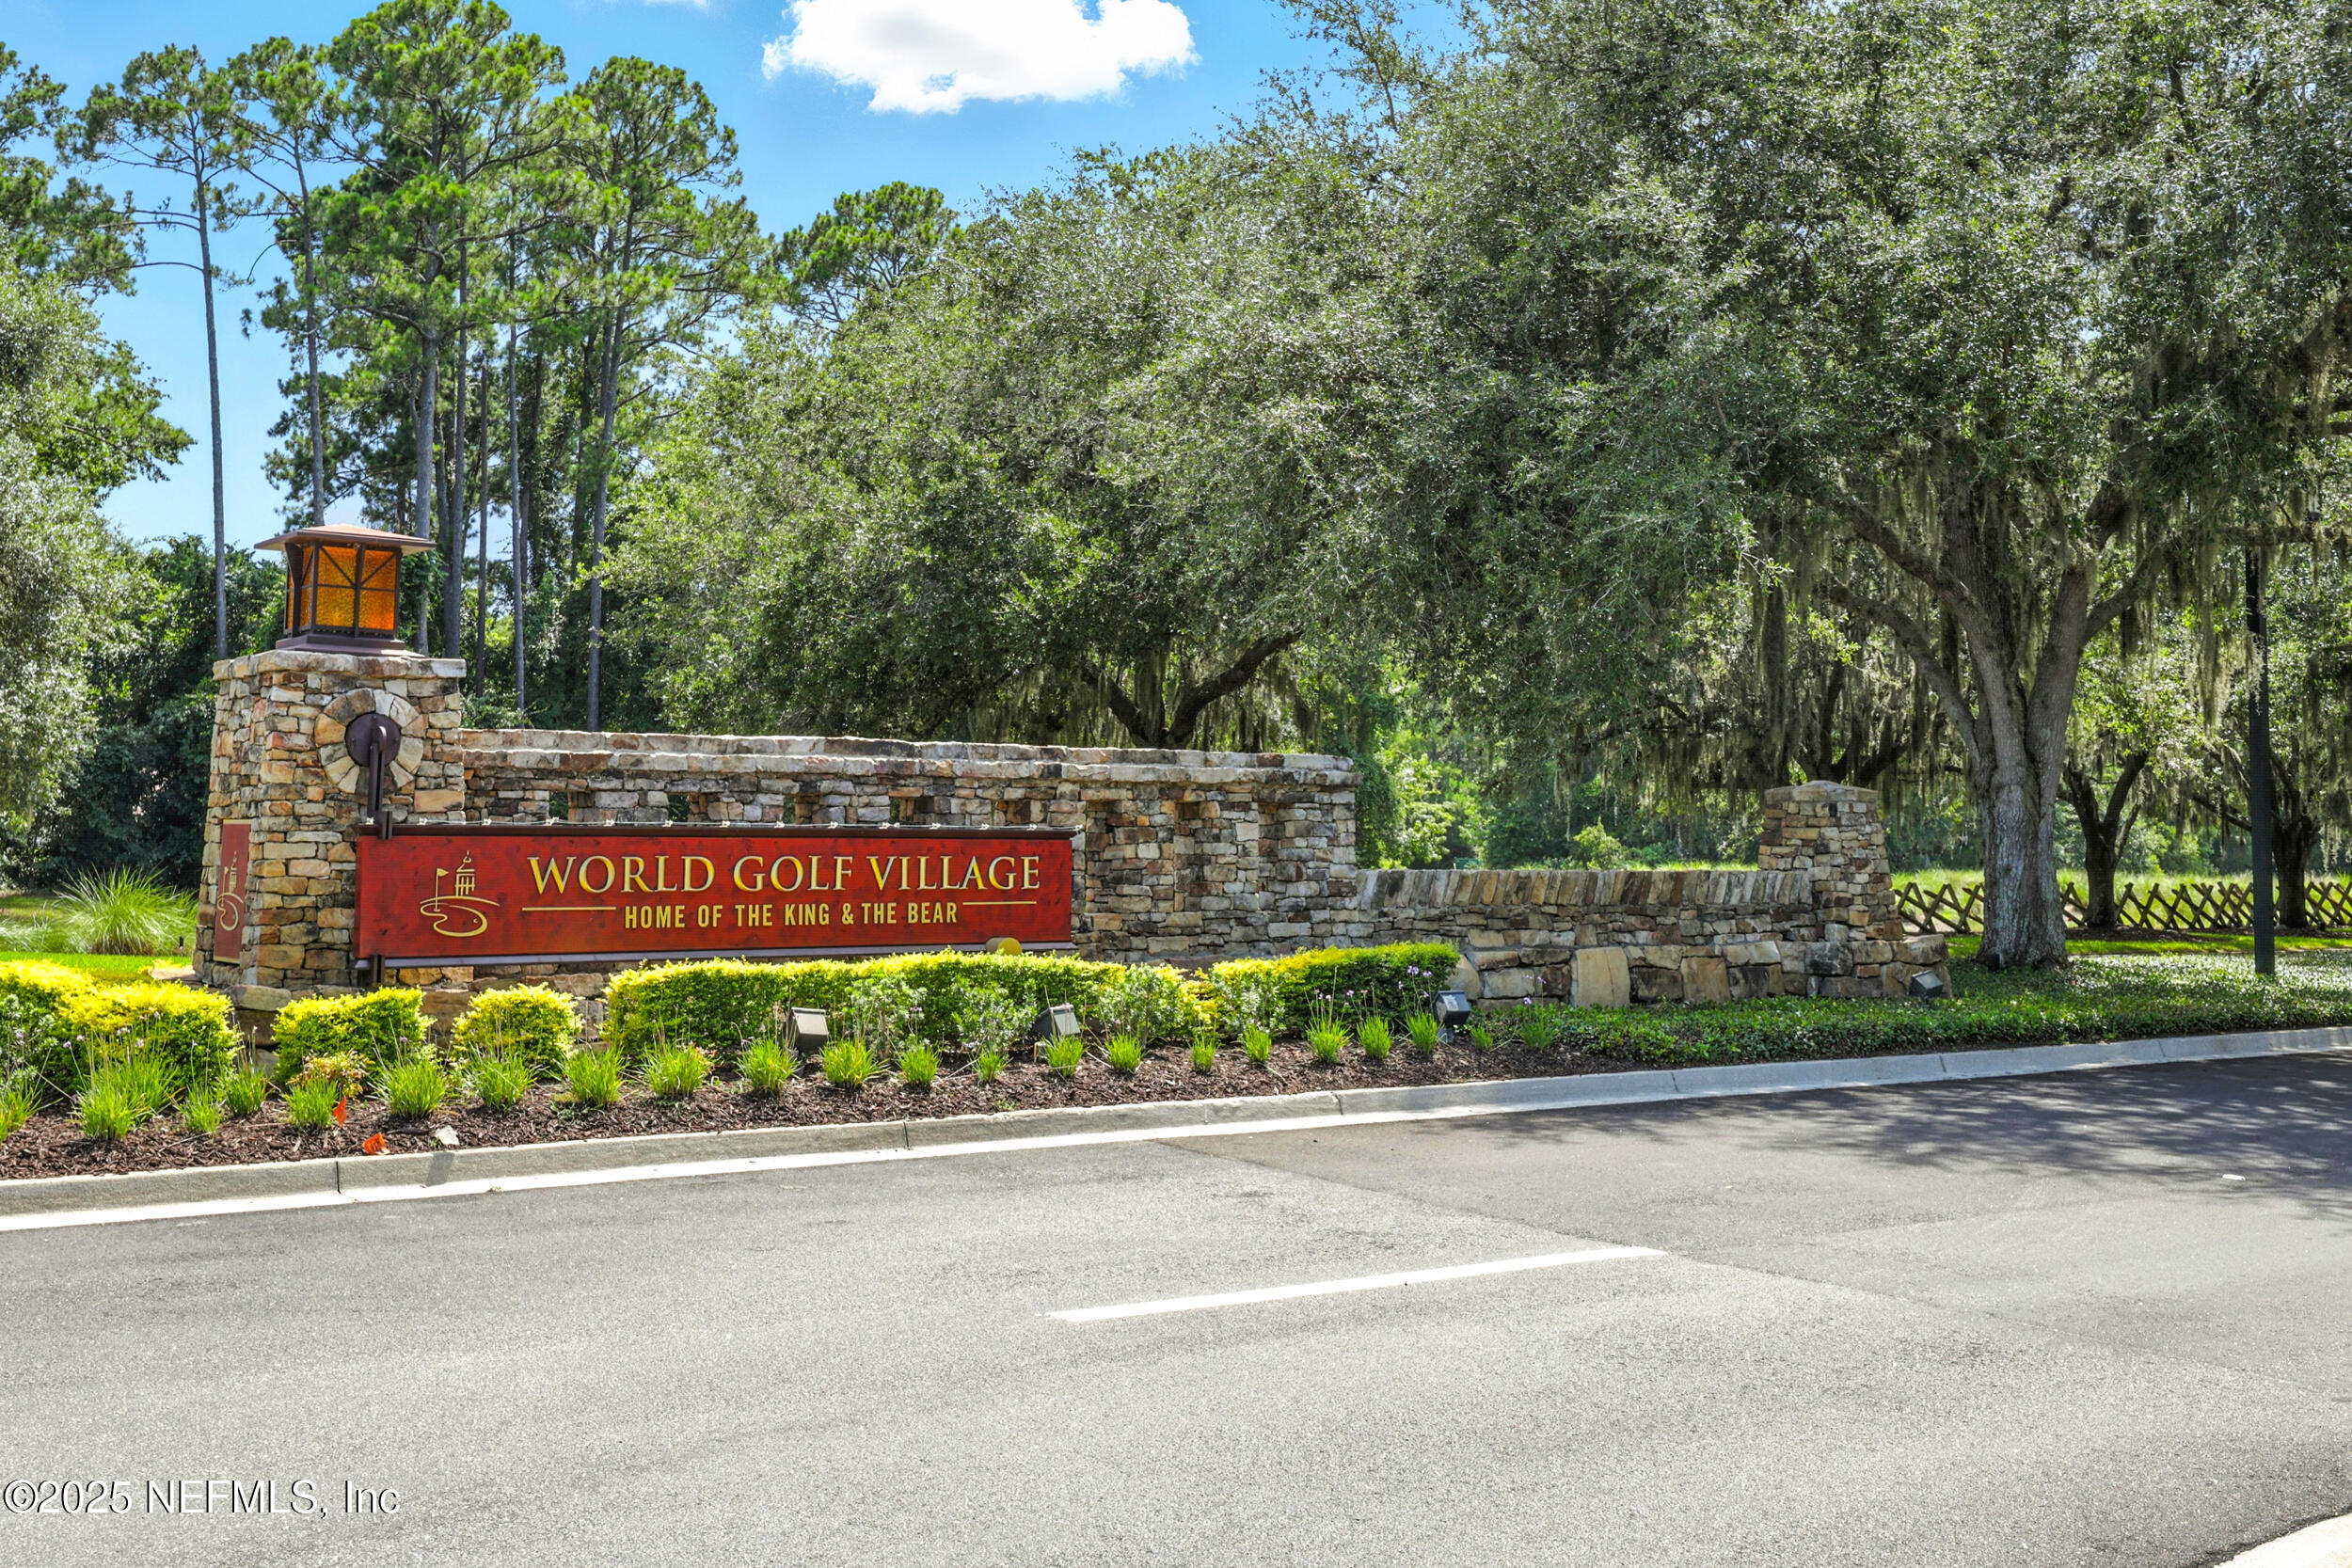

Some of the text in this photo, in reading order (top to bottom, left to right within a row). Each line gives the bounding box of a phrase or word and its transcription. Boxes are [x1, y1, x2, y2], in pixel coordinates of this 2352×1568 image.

[527, 855, 1041, 895] WORLD GOLF VILLAGE
[625, 902, 957, 928] HOME OF THE KING & THE BEAR
